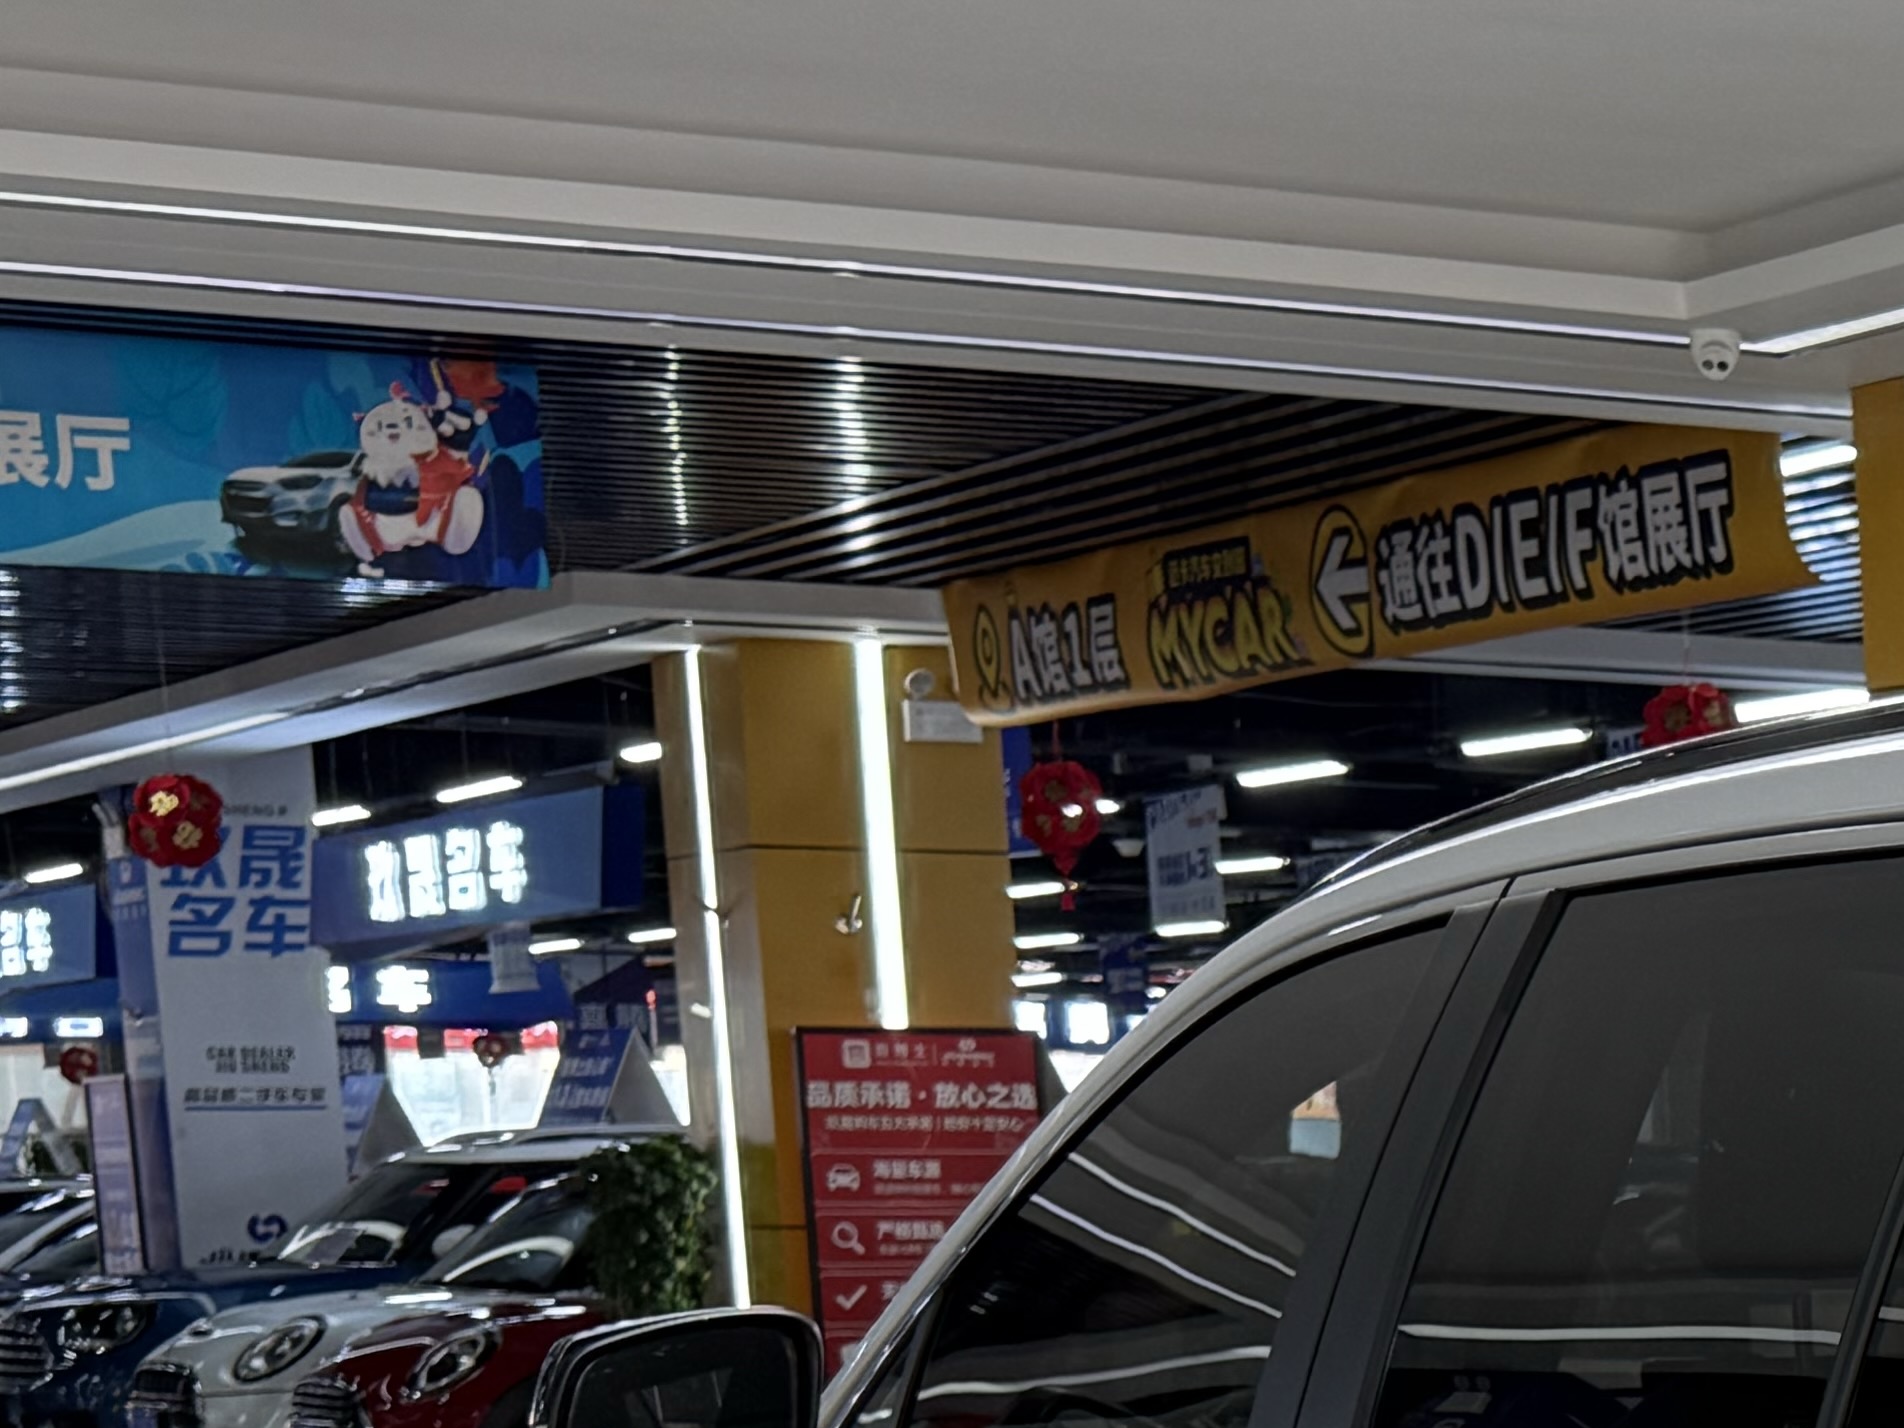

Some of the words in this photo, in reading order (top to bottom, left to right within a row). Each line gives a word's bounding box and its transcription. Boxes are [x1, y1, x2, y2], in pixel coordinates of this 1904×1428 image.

[1376, 459, 1730, 627] 通往D/E/F馆展厅
[1009, 600, 1127, 700] A馆1层
[1149, 583, 1301, 689] MYCAR
[168, 893, 314, 958] 名车
